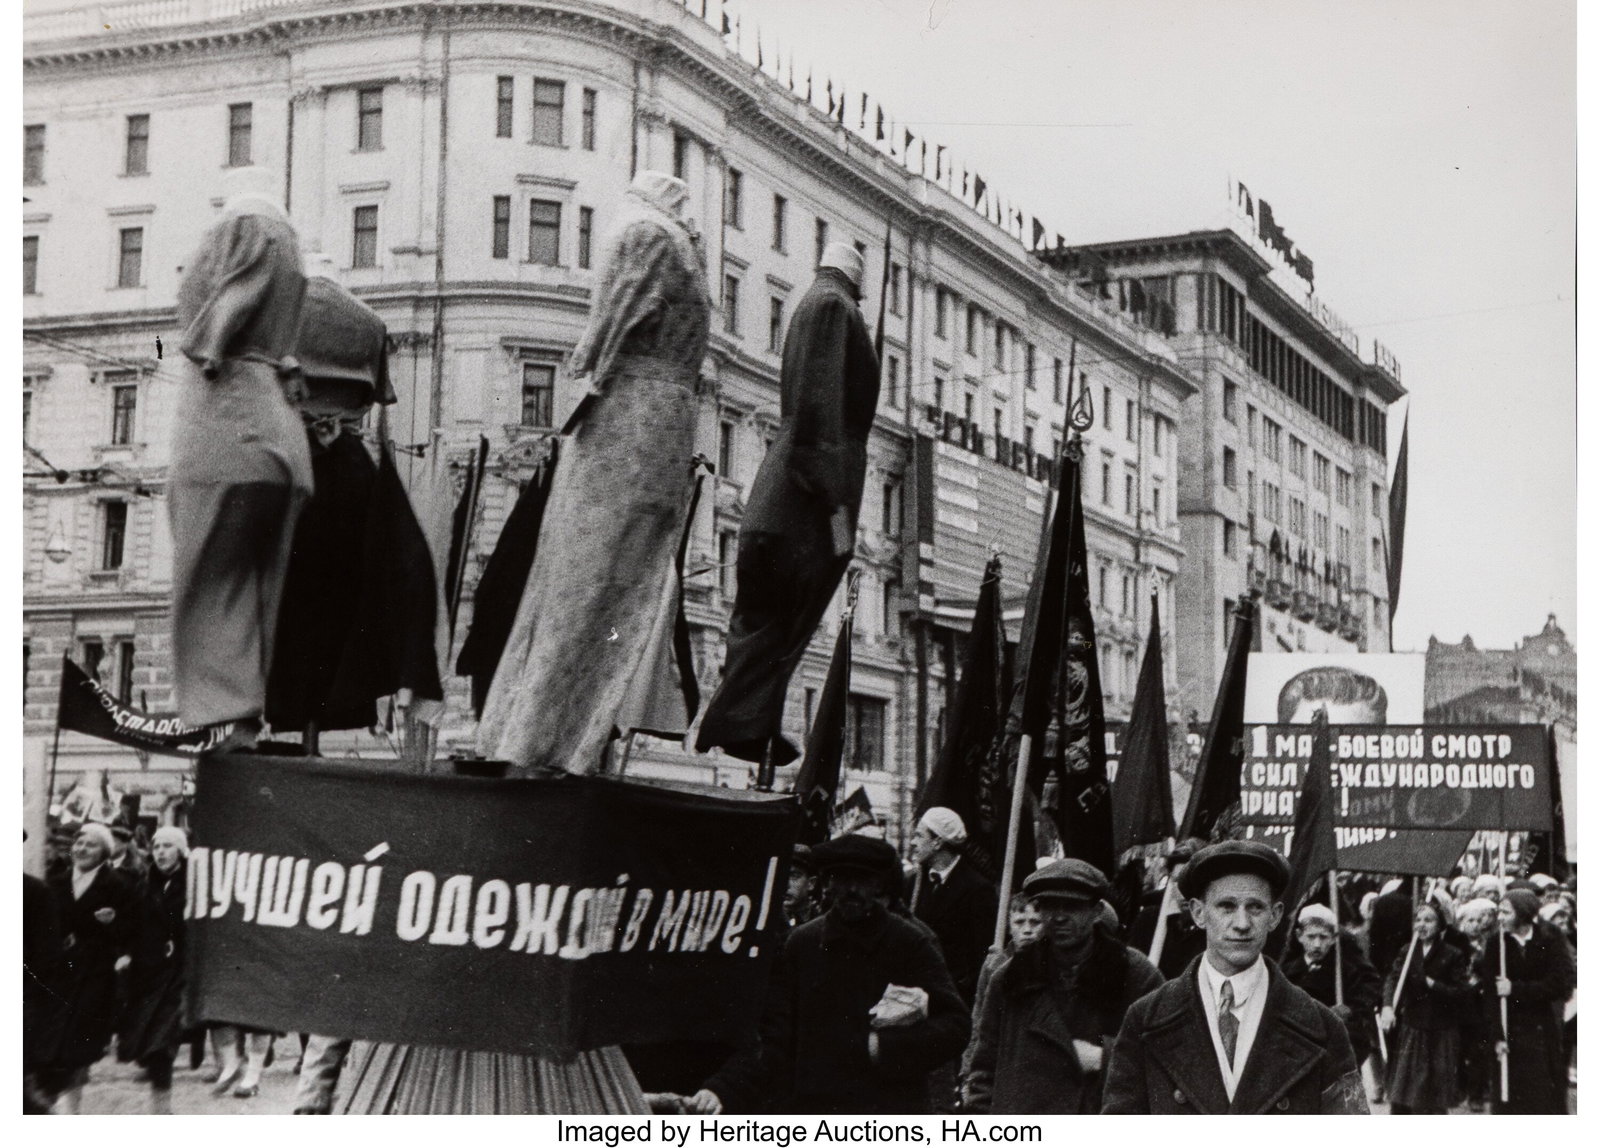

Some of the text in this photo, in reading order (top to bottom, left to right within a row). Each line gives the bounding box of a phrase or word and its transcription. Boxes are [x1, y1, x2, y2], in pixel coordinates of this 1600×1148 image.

[1252, 725, 1268, 758] 1
[1275, 733, 1318, 758] МА
[1432, 734, 1512, 759] СМОТР
[1252, 763, 1298, 786] СИЛ
